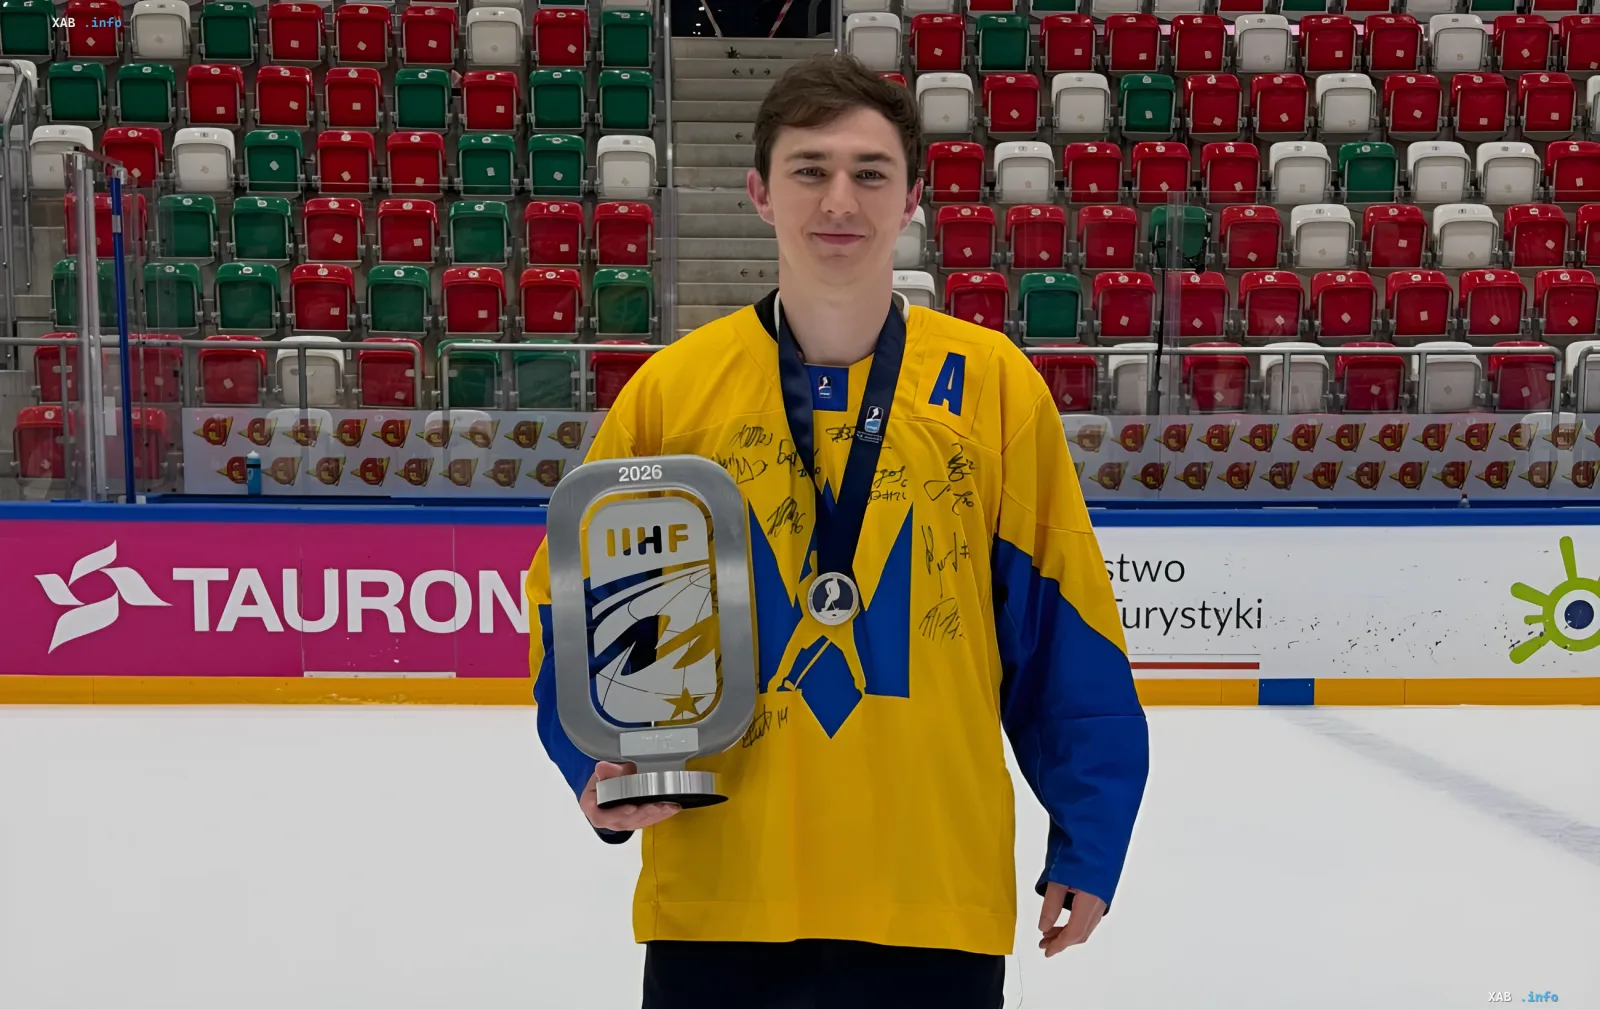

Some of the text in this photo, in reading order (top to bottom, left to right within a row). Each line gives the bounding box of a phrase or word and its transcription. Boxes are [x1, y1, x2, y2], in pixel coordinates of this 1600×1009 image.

[928, 352, 966, 416] A
[618, 465, 663, 482] 2026
[606, 523, 689, 557] IIHF
[172, 567, 531, 634] TAURON
